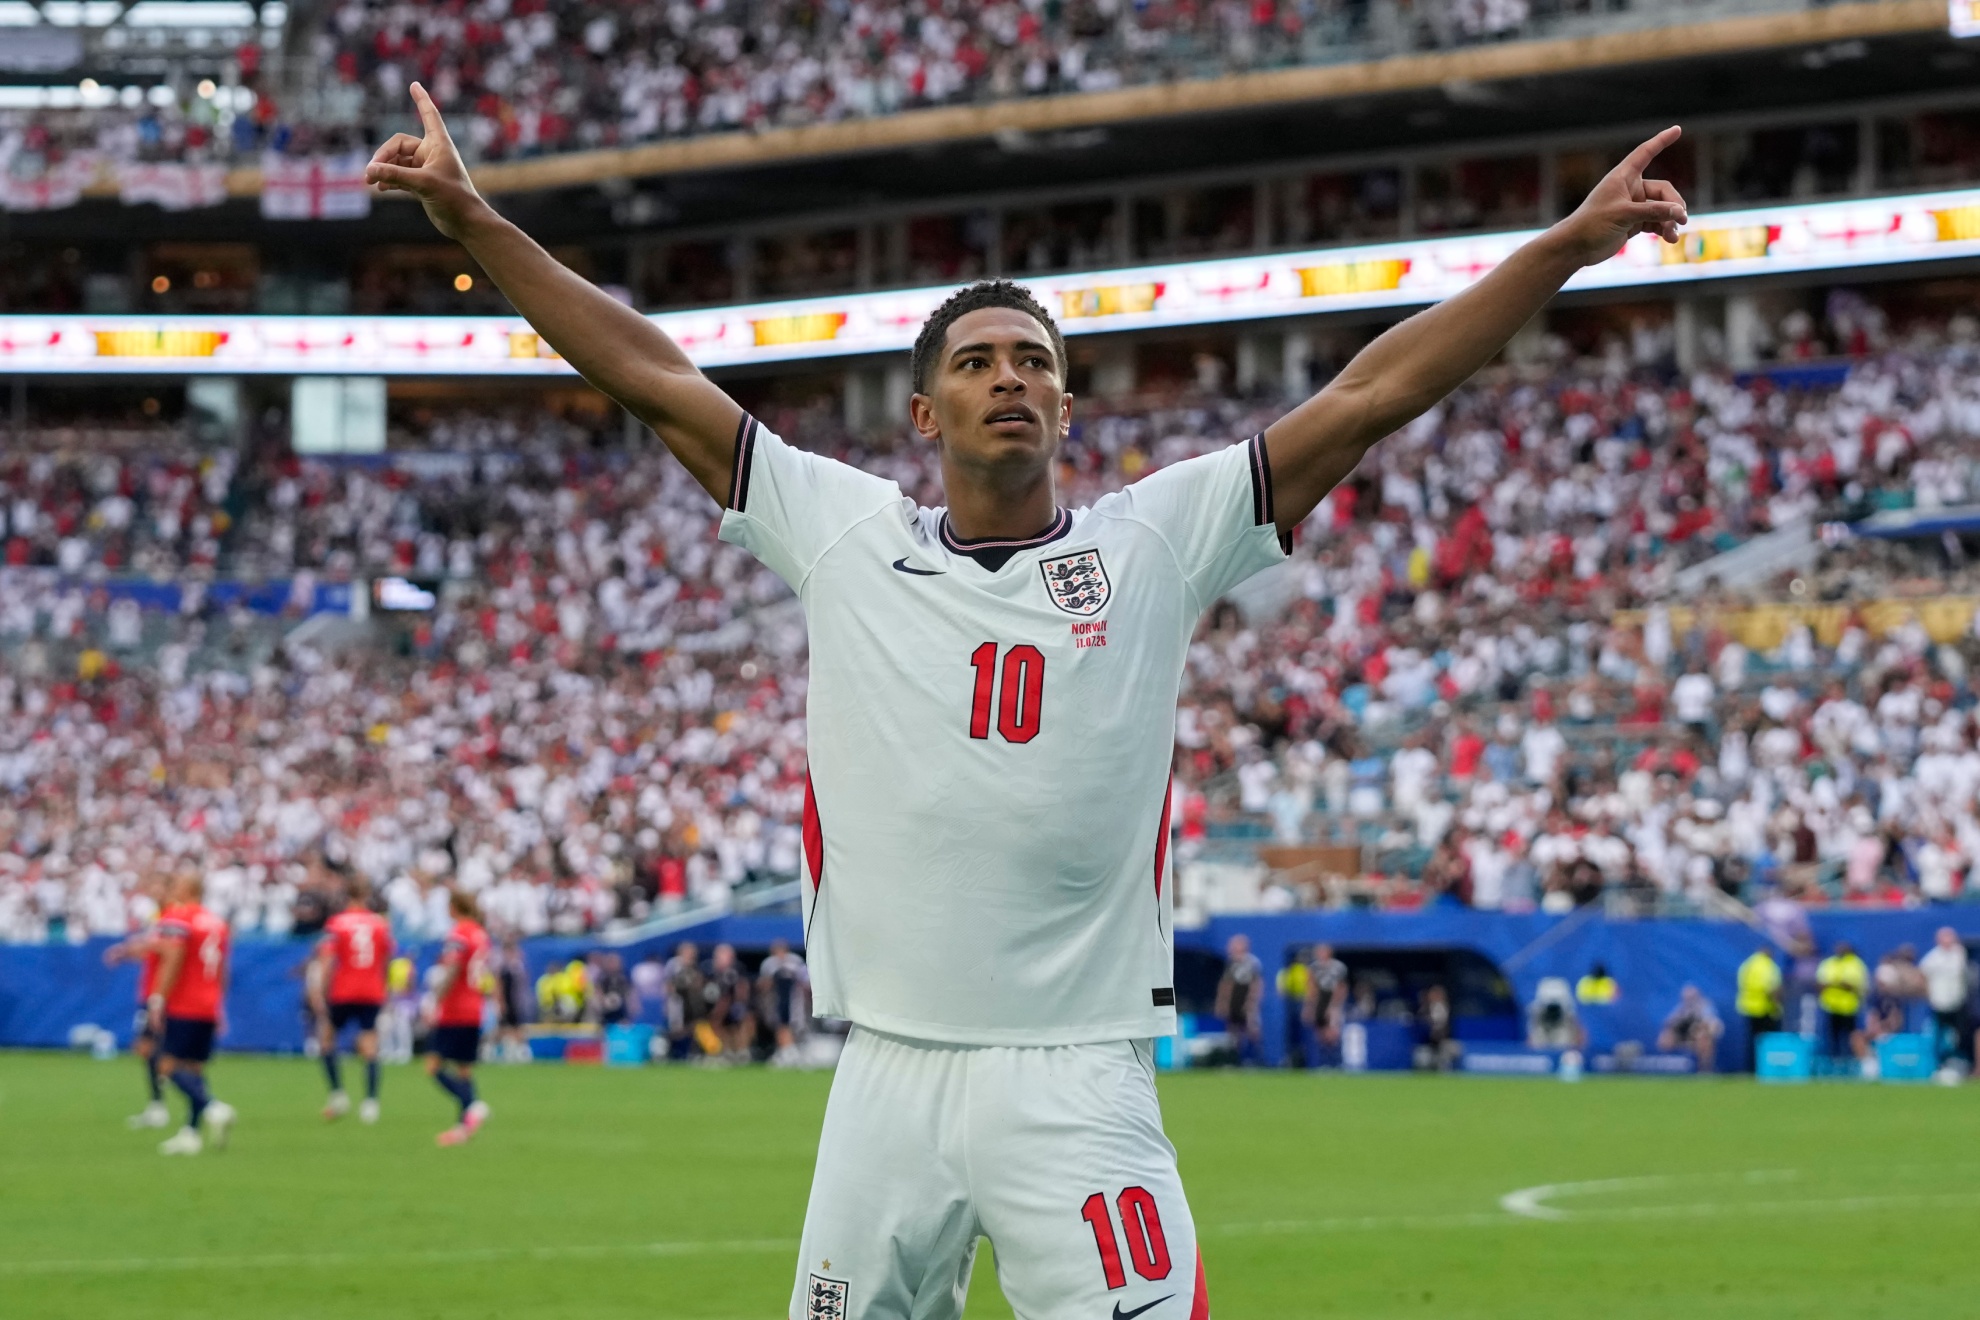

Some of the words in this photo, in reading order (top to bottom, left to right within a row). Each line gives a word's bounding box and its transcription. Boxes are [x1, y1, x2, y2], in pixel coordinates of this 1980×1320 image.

[971, 641, 1045, 744] 10
[1075, 635, 1107, 649] 11.07.26
[1081, 1186, 1172, 1290] 10
